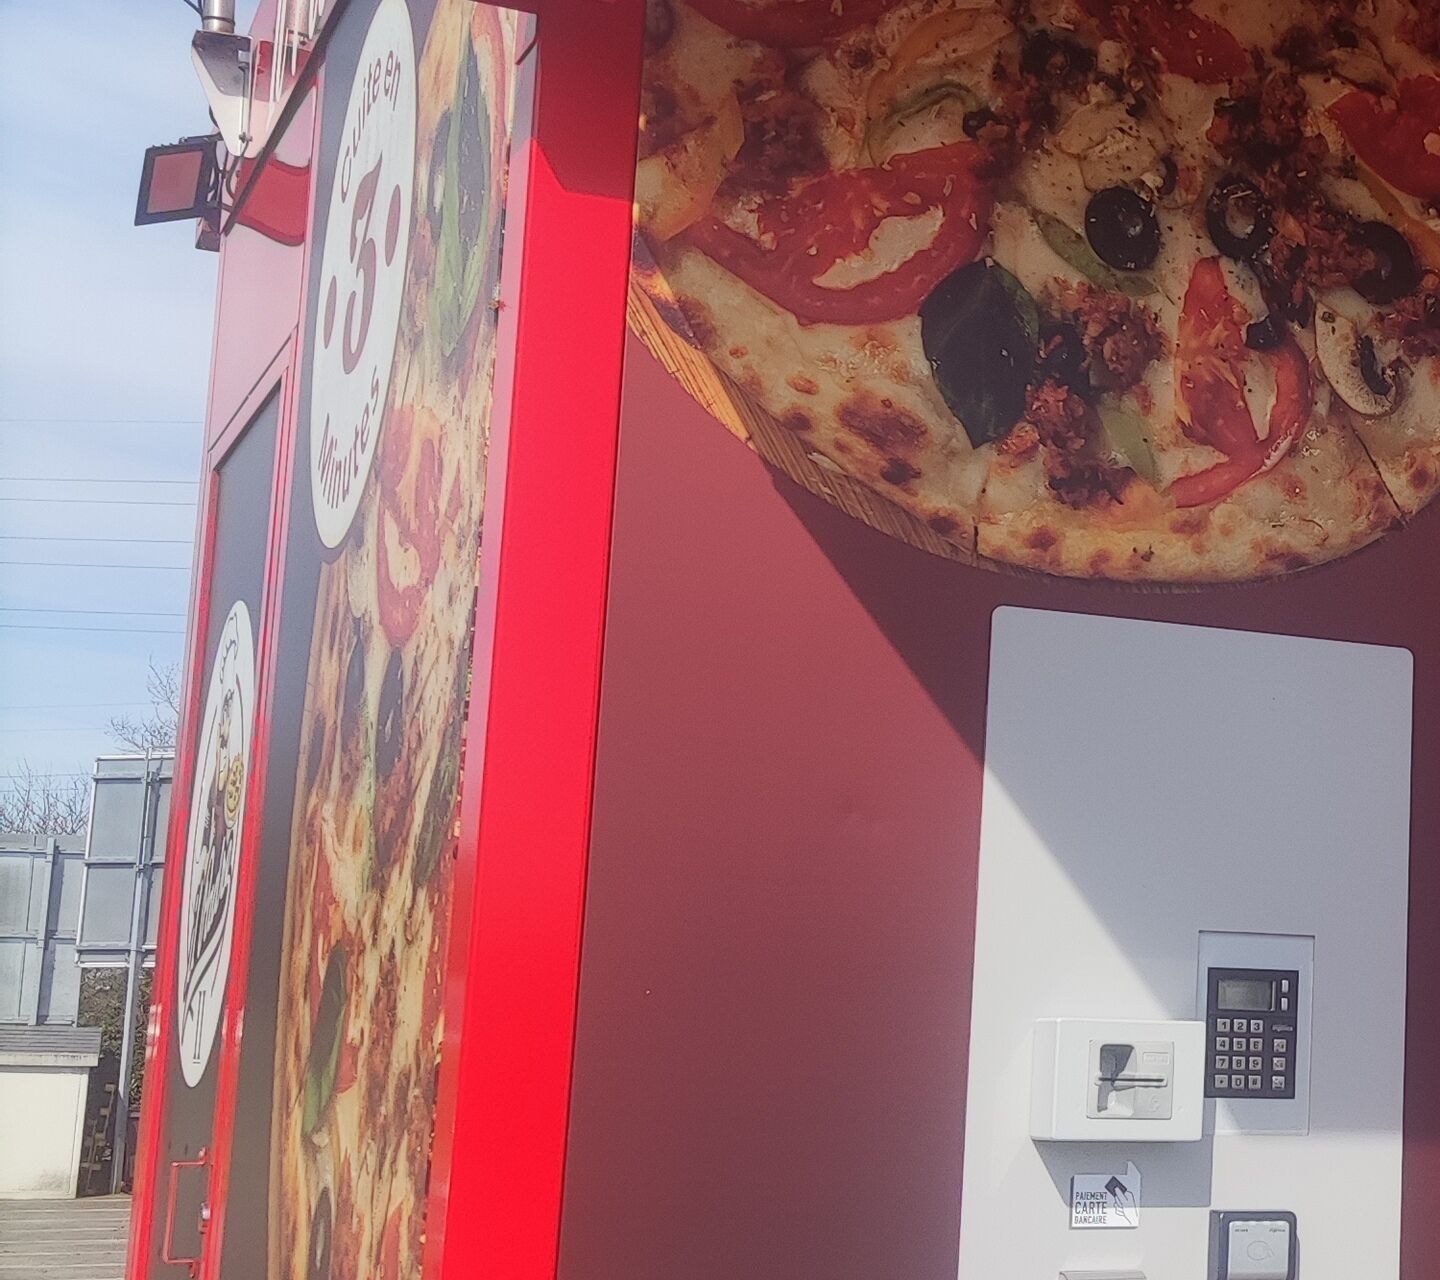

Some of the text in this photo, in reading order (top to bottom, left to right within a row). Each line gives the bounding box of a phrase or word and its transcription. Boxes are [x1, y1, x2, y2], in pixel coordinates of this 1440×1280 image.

[341, 49, 401, 204] Cuite en
[342, 150, 383, 376] 3
[317, 364, 379, 509] Minutes
[1074, 1201, 1108, 1215] CARTE
[1075, 1191, 1108, 1201] PAIEMENT
